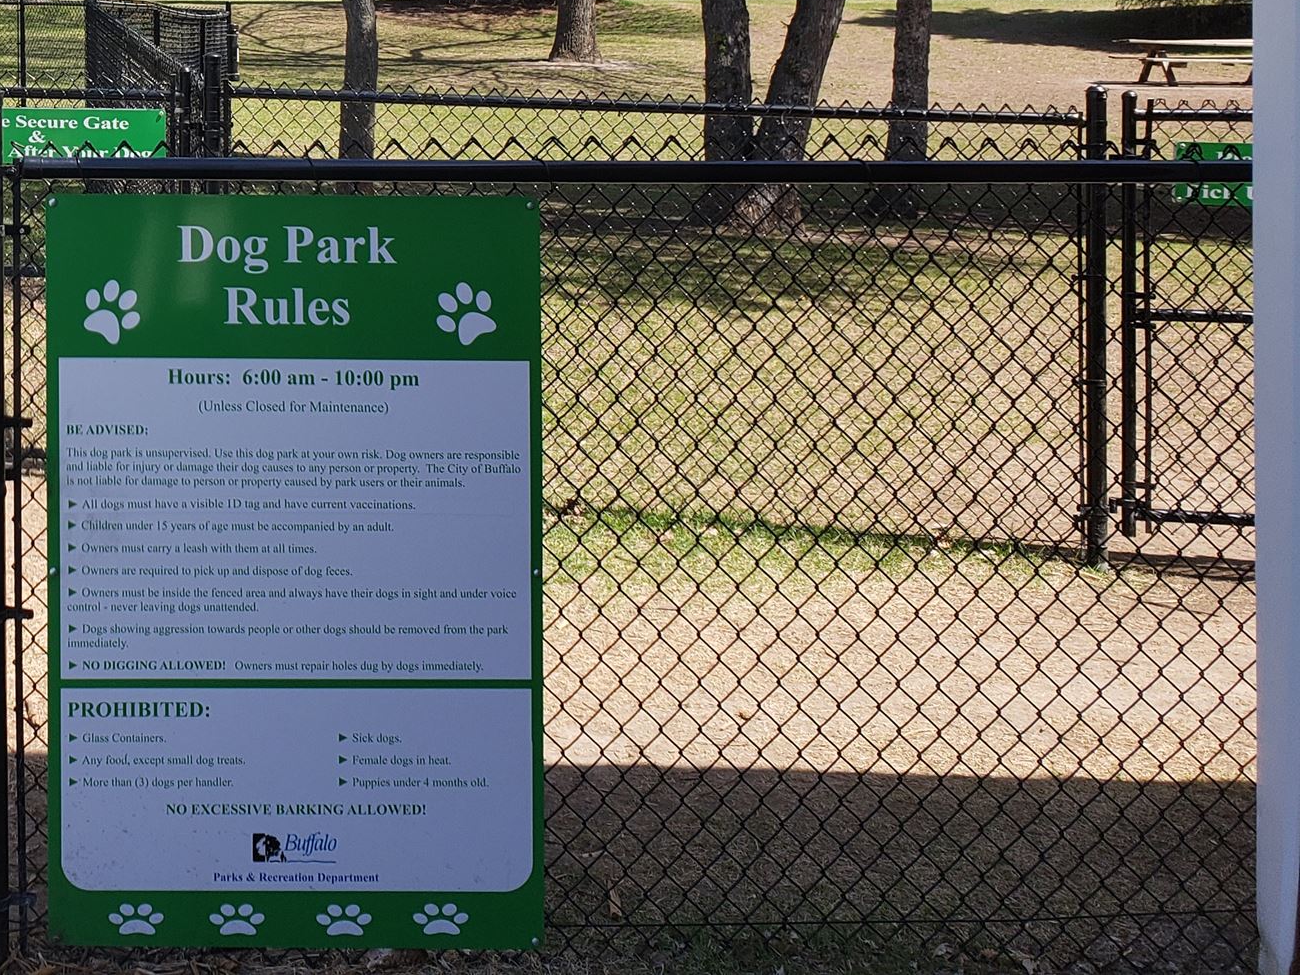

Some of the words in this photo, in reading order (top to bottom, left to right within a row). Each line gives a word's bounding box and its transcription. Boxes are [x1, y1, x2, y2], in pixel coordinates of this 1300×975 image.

[15, 114, 78, 129] Secure
[83, 116, 130, 130] Gate
[28, 130, 46, 143] &
[177, 225, 269, 274] Dog
[282, 225, 398, 264] Park
[223, 286, 351, 326] Rules
[168, 368, 230, 385] Hours:
[242, 368, 281, 385] 6:00
[287, 373, 314, 385] am
[336, 369, 384, 386] 10:00
[390, 374, 418, 389] pm
[198, 400, 242, 414] (Unless
[245, 400, 285, 412] Closed
[289, 400, 306, 412] for
[309, 400, 388, 414] Maintenance)
[66, 424, 83, 435] BE
[82, 499, 97, 509] All
[100, 499, 124, 511] dogs
[127, 500, 151, 508] must
[154, 499, 178, 508] have
[190, 499, 223, 508] visible
[227, 499, 242, 508] ID
[244, 500, 260, 510] tag
[262, 500, 281, 508] and
[284, 500, 308, 508] have
[349, 500, 416, 511] vaccinations.
[81, 521, 122, 530] Children
[125, 521, 153, 530] under
[157, 521, 167, 530] 15
[170, 523, 196, 532] years
[198, 521, 208, 530] of
[211, 523, 228, 532] age
[231, 522, 254, 530] must
[257, 522, 268, 530] be
[271, 522, 334, 533] accompanied
[337, 522, 350, 533] by
[366, 522, 394, 531] adult.
[81, 543, 118, 552] Owners
[121, 544, 144, 553] must
[147, 545, 172, 555] carry
[183, 543, 208, 553] leash
[210, 543, 232, 553] with
[234, 543, 258, 553] them
[261, 545, 270, 553] at
[272, 543, 285, 553] all
[288, 543, 316, 553] times.
[81, 565, 118, 575] Owners
[138, 565, 178, 577] required
[181, 567, 191, 575] to
[193, 565, 214, 577] pick
[217, 568, 229, 577] up
[232, 566, 250, 575] and
[252, 566, 288, 577] dispose
[290, 566, 303, 575] of
[304, 566, 322, 578] dog
[325, 566, 352, 575] feces.
[82, 624, 107, 635] Dogs
[109, 624, 150, 635] showing
[153, 624, 204, 635] aggression
[207, 624, 245, 633] towards
[248, 624, 280, 635] people
[295, 625, 320, 633] other
[323, 625, 346, 636] dogs
[348, 625, 381, 634] should
[383, 625, 395, 634] be
[398, 625, 440, 634] removed
[443, 625, 466, 634] from
[469, 625, 484, 634] the
[486, 625, 508, 636] park
[67, 638, 128, 649] immediately.
[82, 660, 100, 670] NO
[103, 660, 157, 670] DIGGING
[160, 660, 225, 670] ALLOWED!
[234, 660, 272, 670] Owners
[274, 662, 298, 670] must
[300, 661, 329, 672] repair
[332, 661, 357, 670] holes
[360, 661, 378, 672] dug
[381, 661, 393, 672] by
[396, 661, 419, 672] dogs
[422, 661, 483, 672] immediately.
[68, 701, 209, 717] PROHIBITED:
[82, 733, 109, 743] Glass
[111, 733, 166, 742] Containers.
[352, 733, 373, 742] Sick
[376, 733, 401, 745] dogs.
[81, 755, 102, 767] Any
[105, 753, 130, 765] food,
[132, 756, 164, 767] except
[167, 754, 192, 764] small
[196, 754, 214, 767] dog
[216, 756, 245, 765] treats.
[352, 755, 387, 765] Female
[390, 755, 413, 767] dogs
[416, 755, 425, 764] in
[428, 755, 451, 765] heat.
[82, 777, 108, 786] More
[111, 777, 132, 787] than
[134, 777, 148, 788] (3)
[151, 777, 174, 789] dogs
[177, 779, 192, 789] per
[195, 777, 233, 786] handler.
[352, 777, 390, 789] Puppies
[393, 777, 420, 787] under
[423, 777, 429, 786] 4
[432, 777, 468, 787] months
[470, 777, 488, 787] old.
[166, 803, 187, 815] NO
[191, 803, 271, 815] EXCESSIVE
[276, 804, 343, 815] BARKING
[347, 803, 426, 815] ALLOWED!
[283, 831, 337, 856] Buffalo
[213, 872, 242, 881] Parks
[246, 872, 255, 881] &
[259, 872, 314, 881] Recreation
[317, 873, 378, 884] Department
